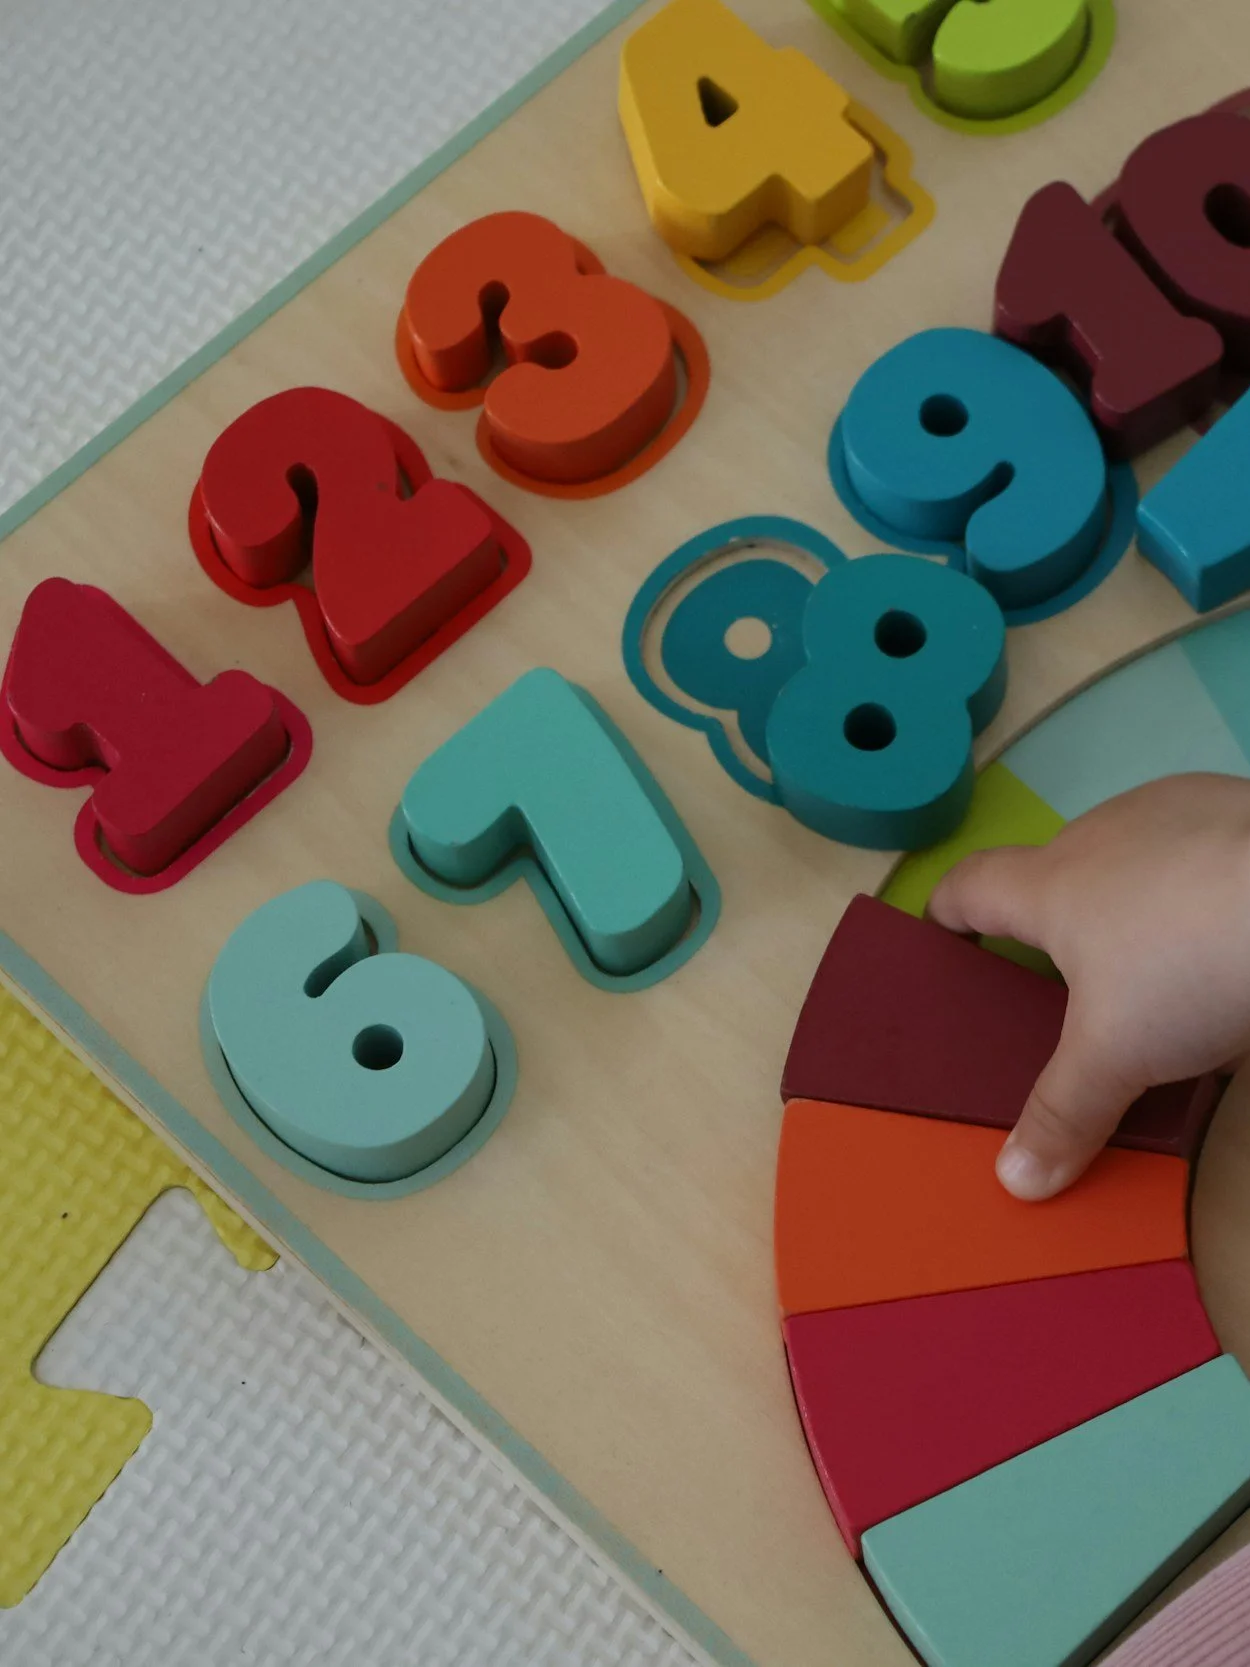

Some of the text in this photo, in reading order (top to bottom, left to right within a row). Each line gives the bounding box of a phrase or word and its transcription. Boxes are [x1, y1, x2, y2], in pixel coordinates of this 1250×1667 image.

[4, 576, 294, 877] 1
[200, 386, 508, 686] 2
[404, 211, 680, 485] 3
[618, 0, 875, 263] 4
[841, 327, 1107, 606] 9
[401, 667, 692, 977] 7
[766, 553, 1007, 850] 8
[208, 879, 498, 1184] 6
